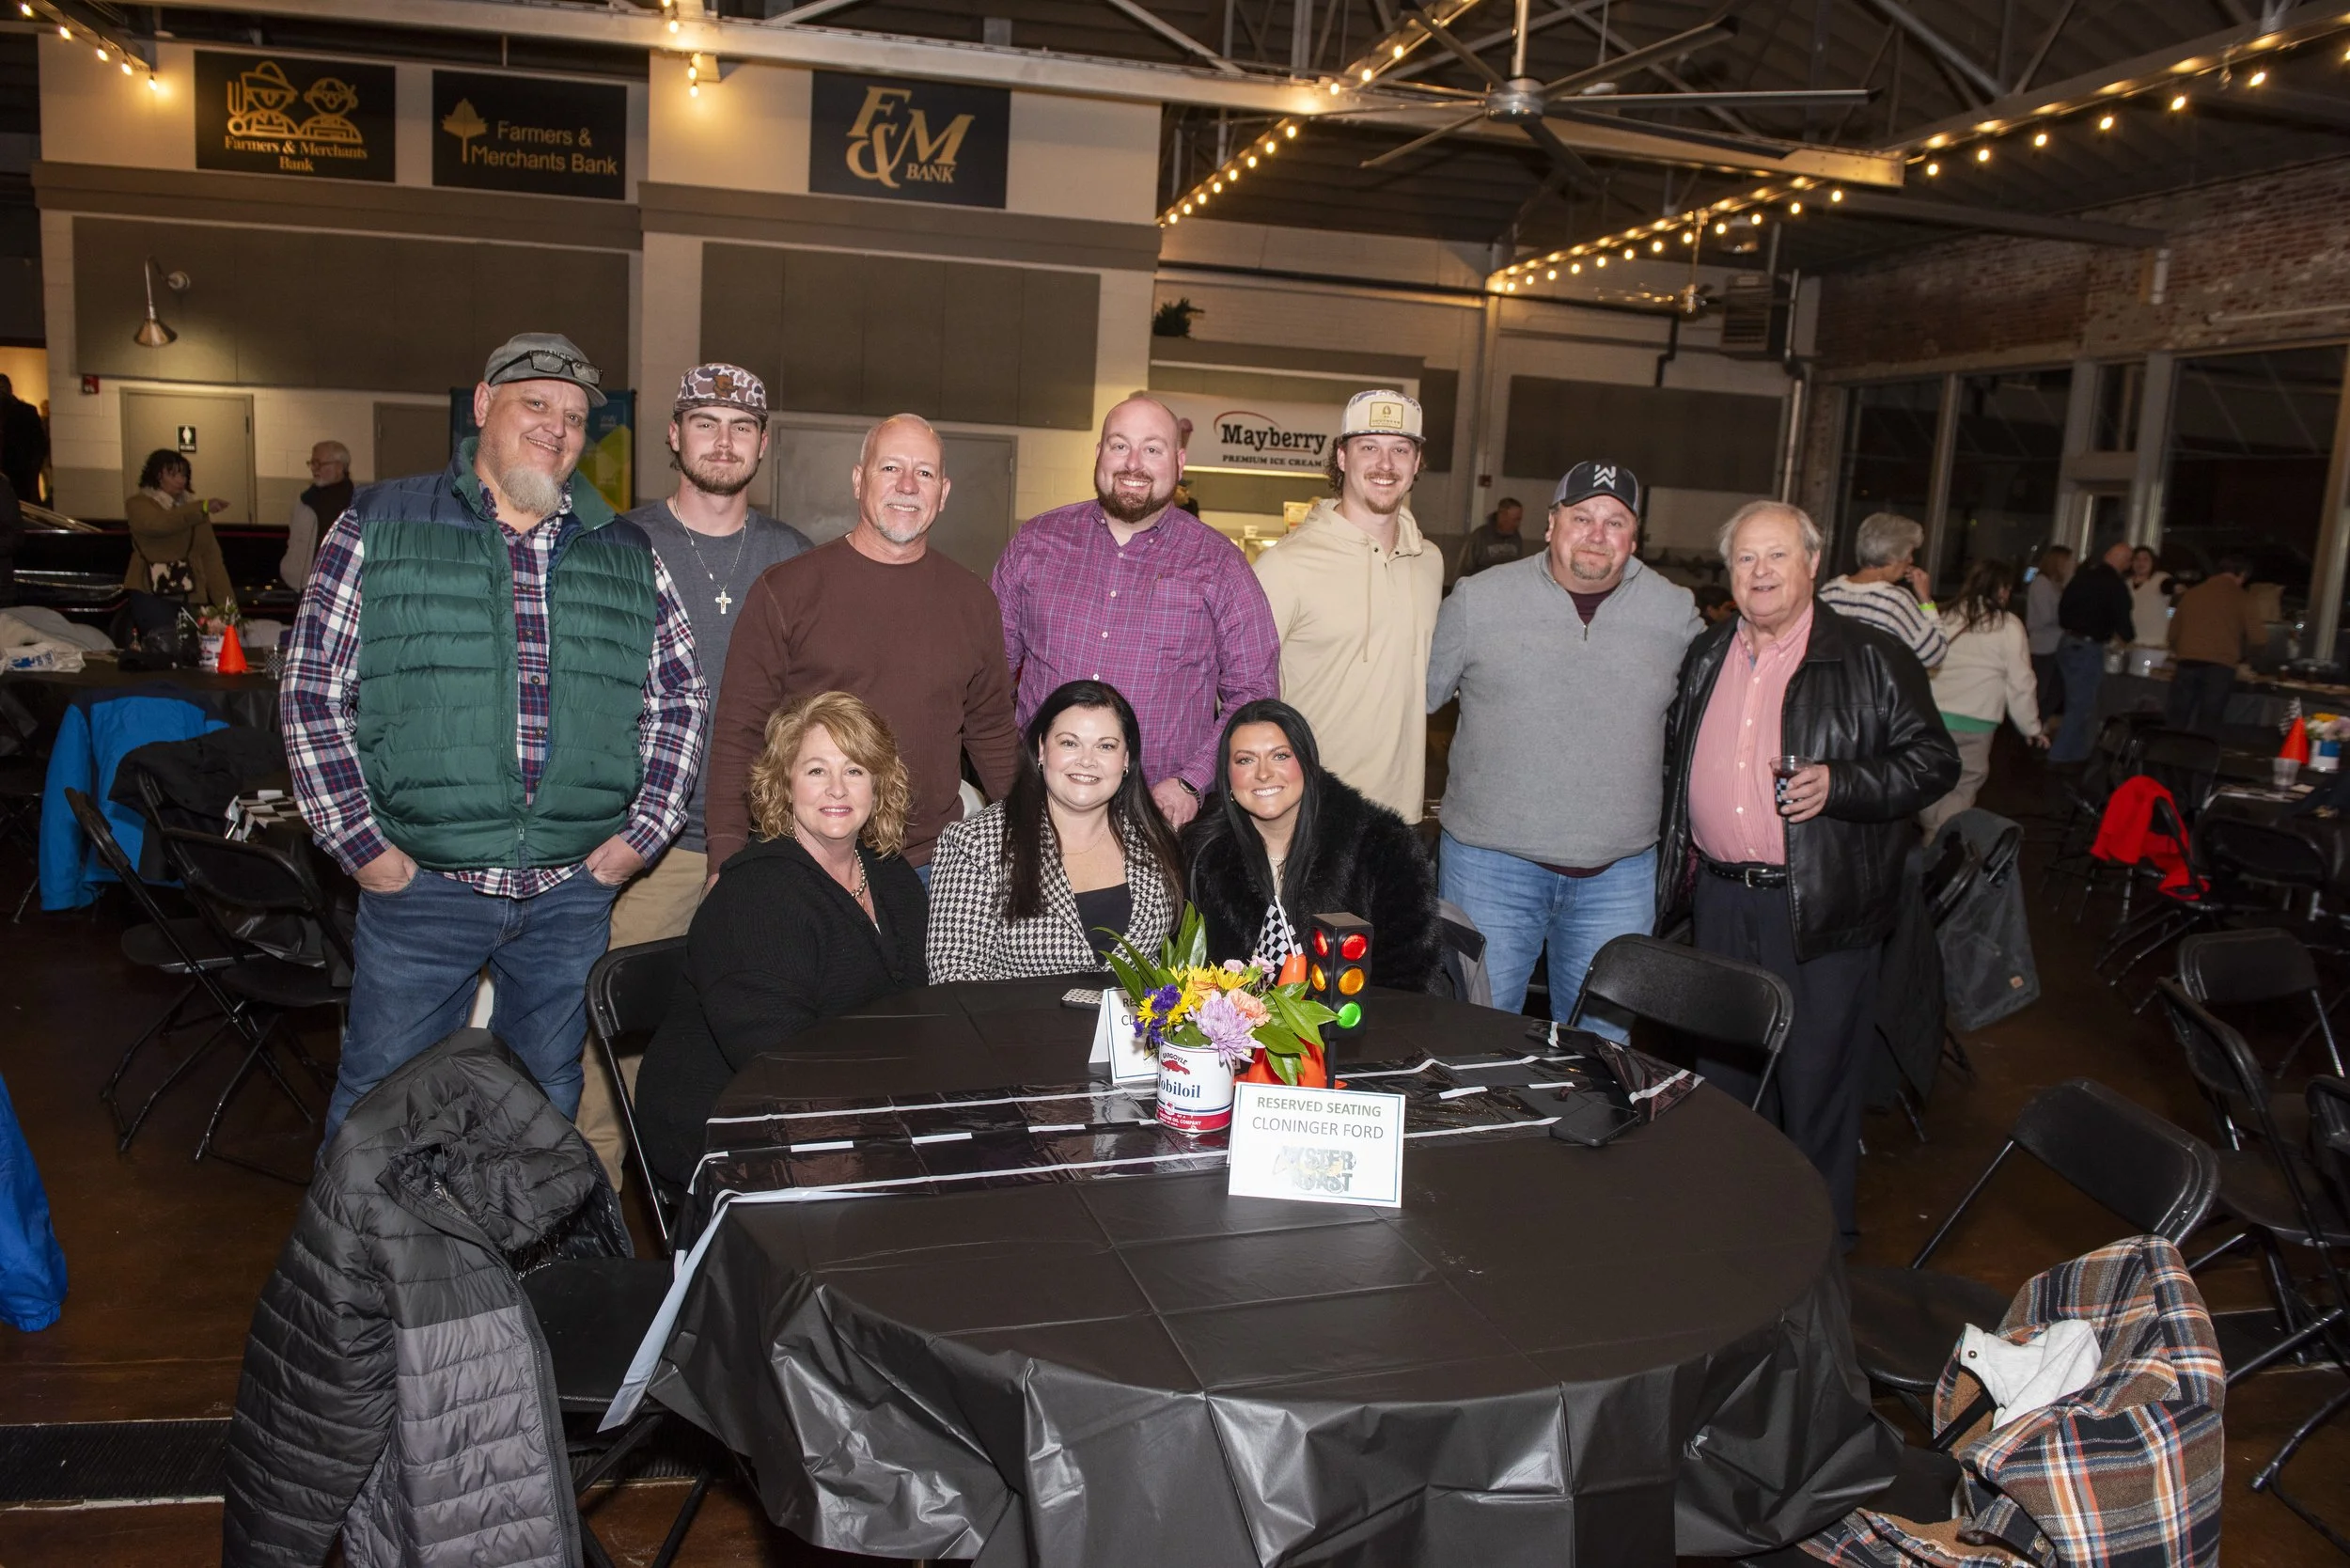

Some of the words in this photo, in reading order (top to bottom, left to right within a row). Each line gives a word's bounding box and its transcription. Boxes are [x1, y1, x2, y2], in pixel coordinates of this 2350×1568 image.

[224, 134, 280, 153] Farmers
[282, 139, 296, 154] &
[300, 141, 368, 160] Merchants
[497, 119, 573, 147] Farmers
[578, 127, 592, 149] &
[846, 86, 976, 188] F&M
[279, 155, 314, 172] Bank
[471, 144, 567, 172] Merchants
[571, 152, 619, 176] Bank
[906, 163, 957, 183] BANK
[1221, 423, 1327, 455] Mayberry
[1222, 454, 1267, 464] PREMIUM
[1270, 457, 1286, 465] ICE
[1288, 459, 1323, 467] CREAM
[1158, 1073, 1200, 1099] obiloil
[1257, 1096, 1323, 1112] RESERVED
[1327, 1102, 1382, 1117] SEATING
[1252, 1116, 1339, 1137] CLONINGER
[1343, 1123, 1384, 1139] FORD
